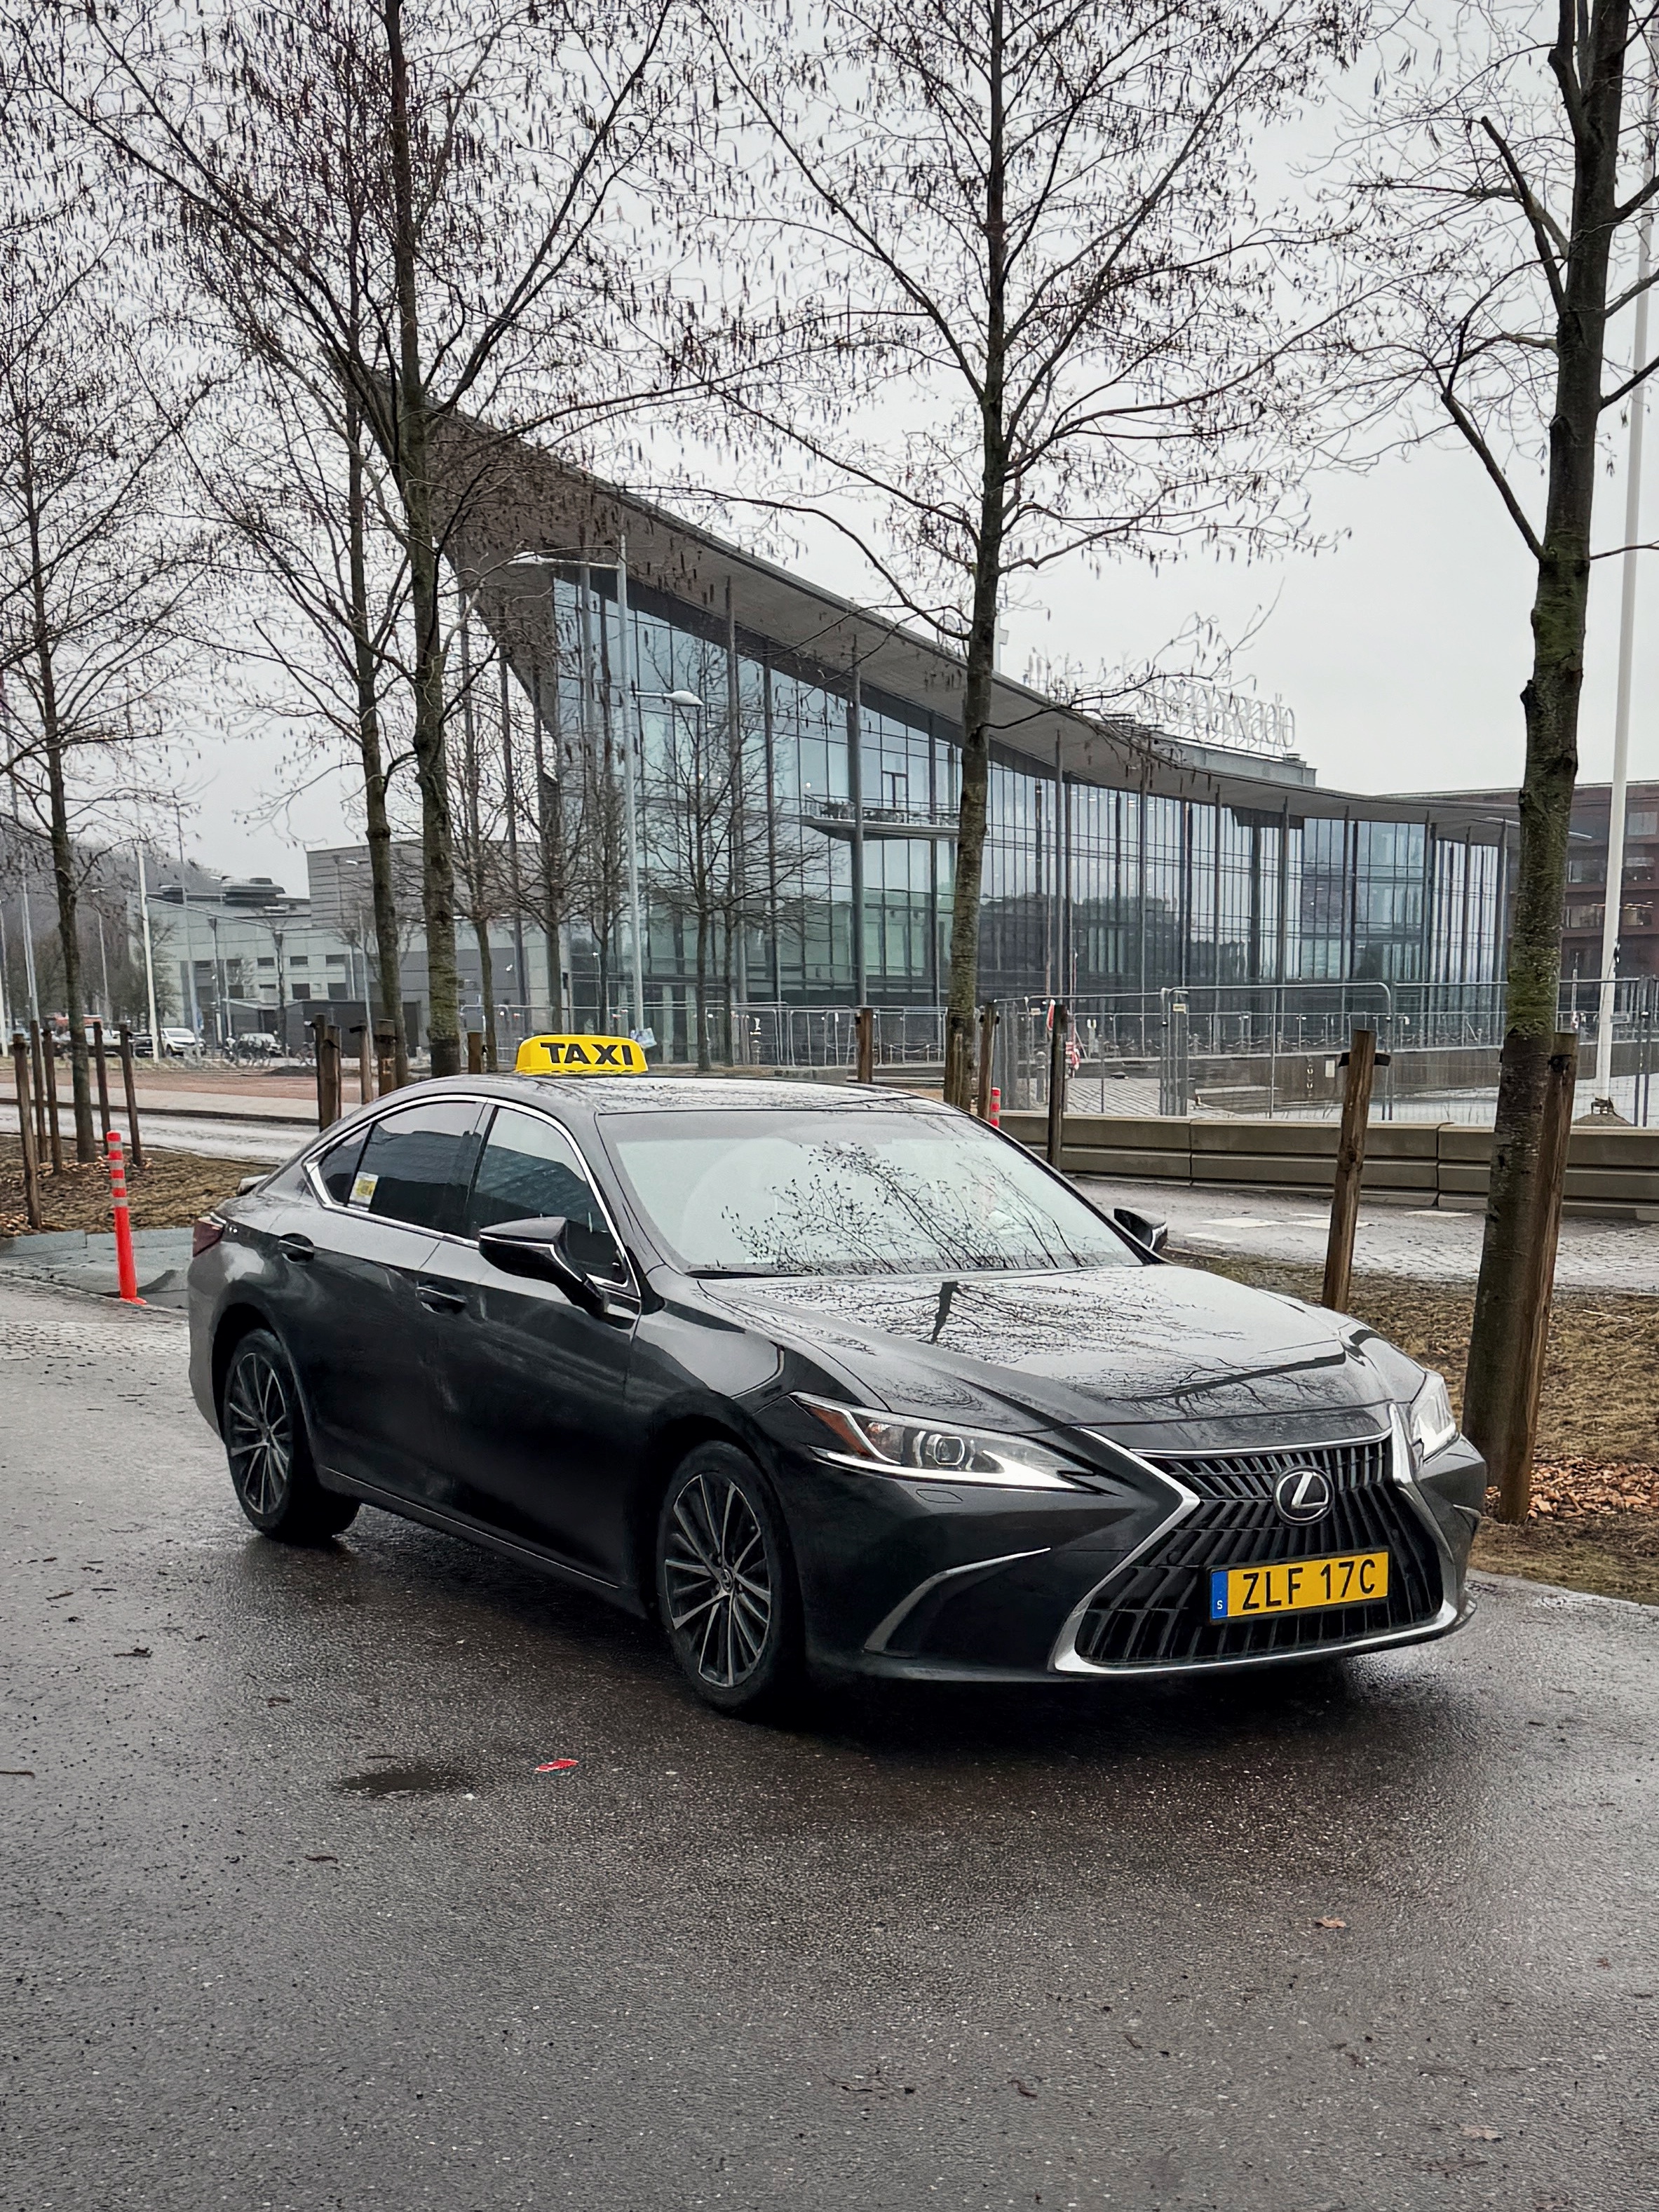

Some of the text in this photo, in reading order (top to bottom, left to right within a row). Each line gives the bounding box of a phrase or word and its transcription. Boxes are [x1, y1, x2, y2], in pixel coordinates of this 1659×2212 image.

[540, 1042, 634, 1066] TAXI
[1242, 1558, 1376, 1610] ZLF 17C
[1217, 1599, 1224, 1610] S
